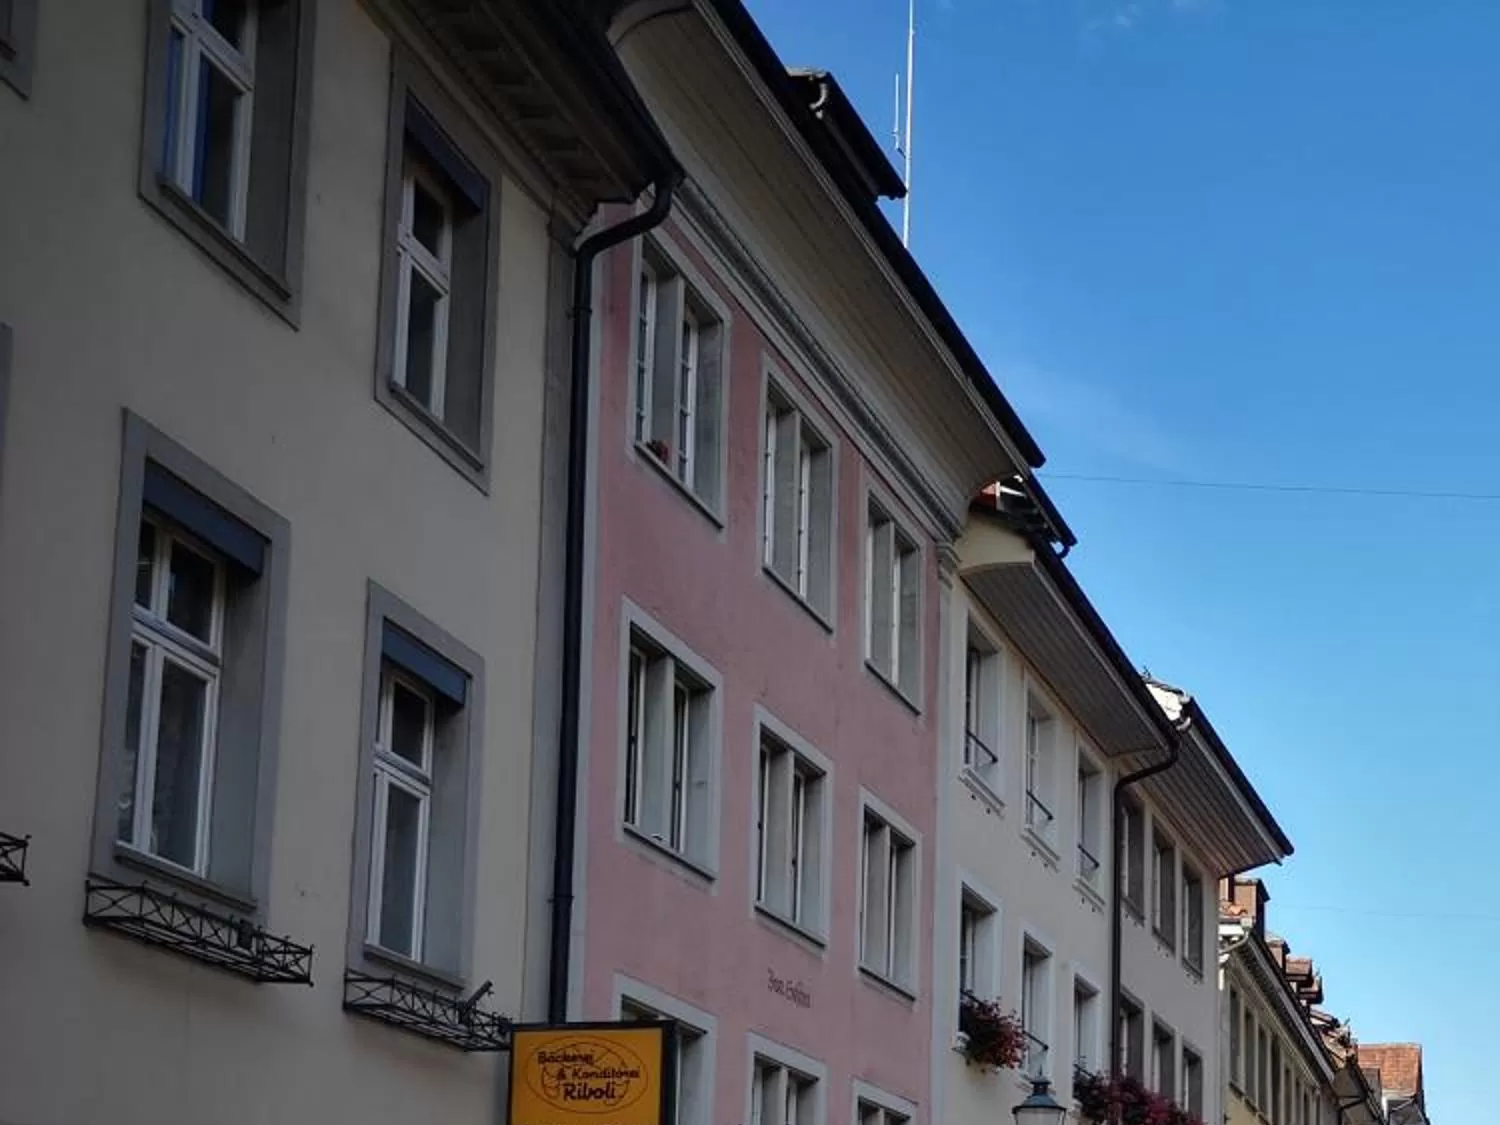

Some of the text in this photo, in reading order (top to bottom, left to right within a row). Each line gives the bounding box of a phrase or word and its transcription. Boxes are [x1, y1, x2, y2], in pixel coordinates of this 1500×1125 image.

[537, 1050, 594, 1065] Bäckerei
[573, 1066, 641, 1080] Konditorei
[563, 1081, 616, 1101] Riboli
